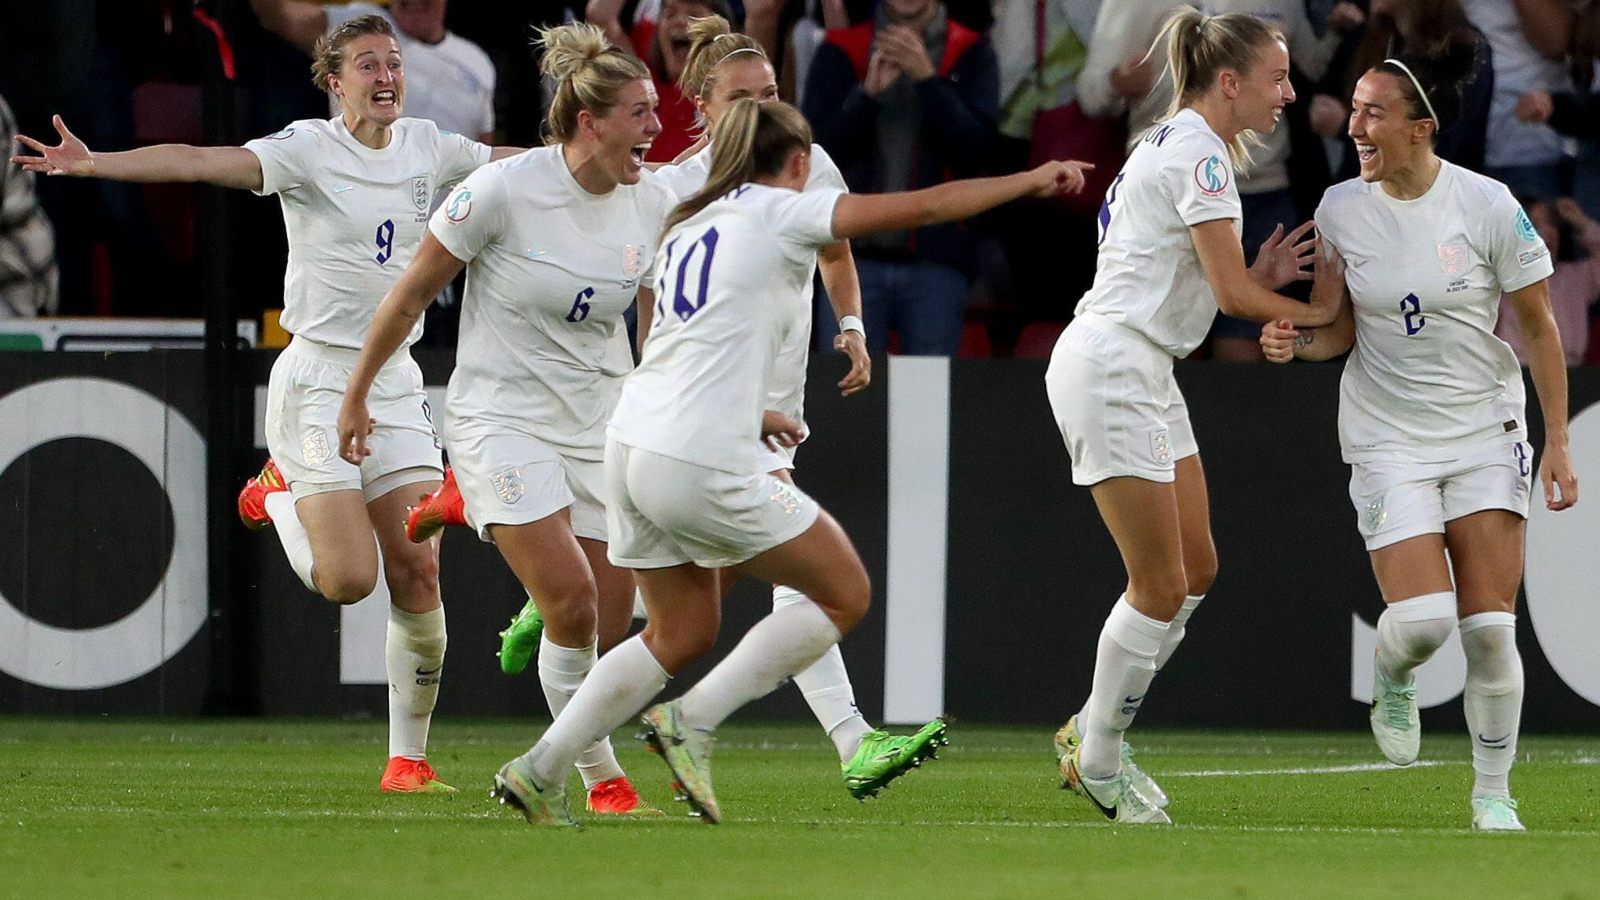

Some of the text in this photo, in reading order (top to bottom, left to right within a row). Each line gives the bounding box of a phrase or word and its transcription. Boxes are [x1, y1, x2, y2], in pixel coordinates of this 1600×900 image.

[375, 218, 395, 265] 9
[652, 225, 719, 327] 10
[565, 286, 595, 323] 6
[1399, 293, 1425, 336] 2
